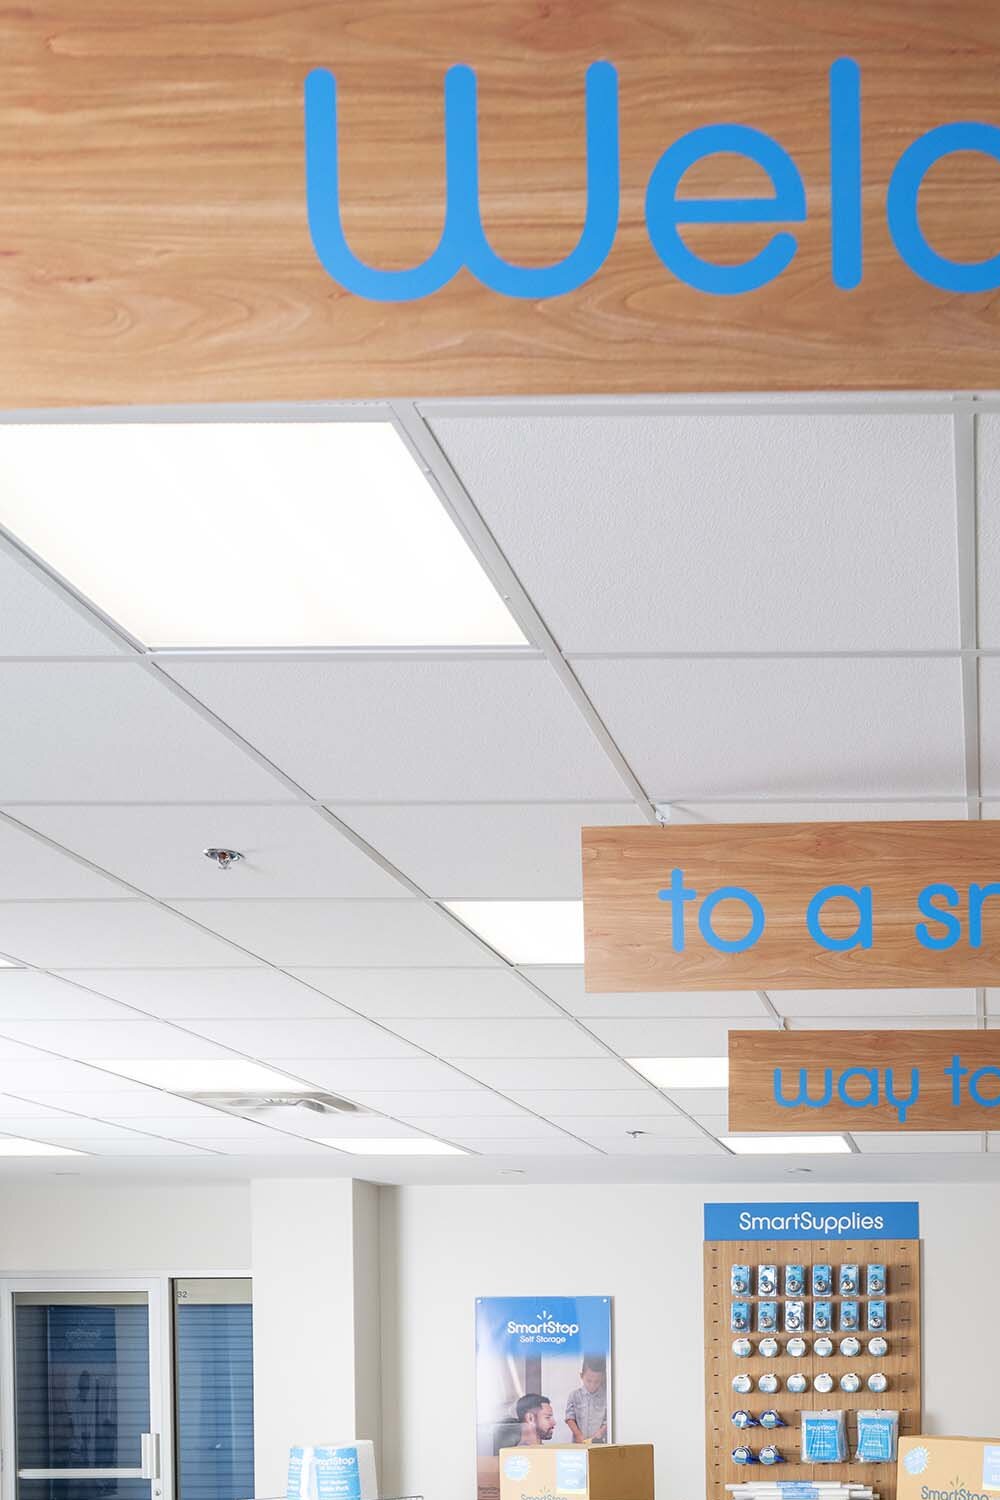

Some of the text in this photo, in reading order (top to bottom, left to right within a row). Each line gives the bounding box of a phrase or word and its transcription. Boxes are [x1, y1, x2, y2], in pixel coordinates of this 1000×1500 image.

[659, 868, 765, 953] to
[806, 885, 873, 950] a
[774, 1067, 919, 1122] way
[739, 1211, 884, 1234] SmartSupplies
[507, 1320, 579, 1337] SmartStop
[520, 1335, 567, 1345] Self Storage
